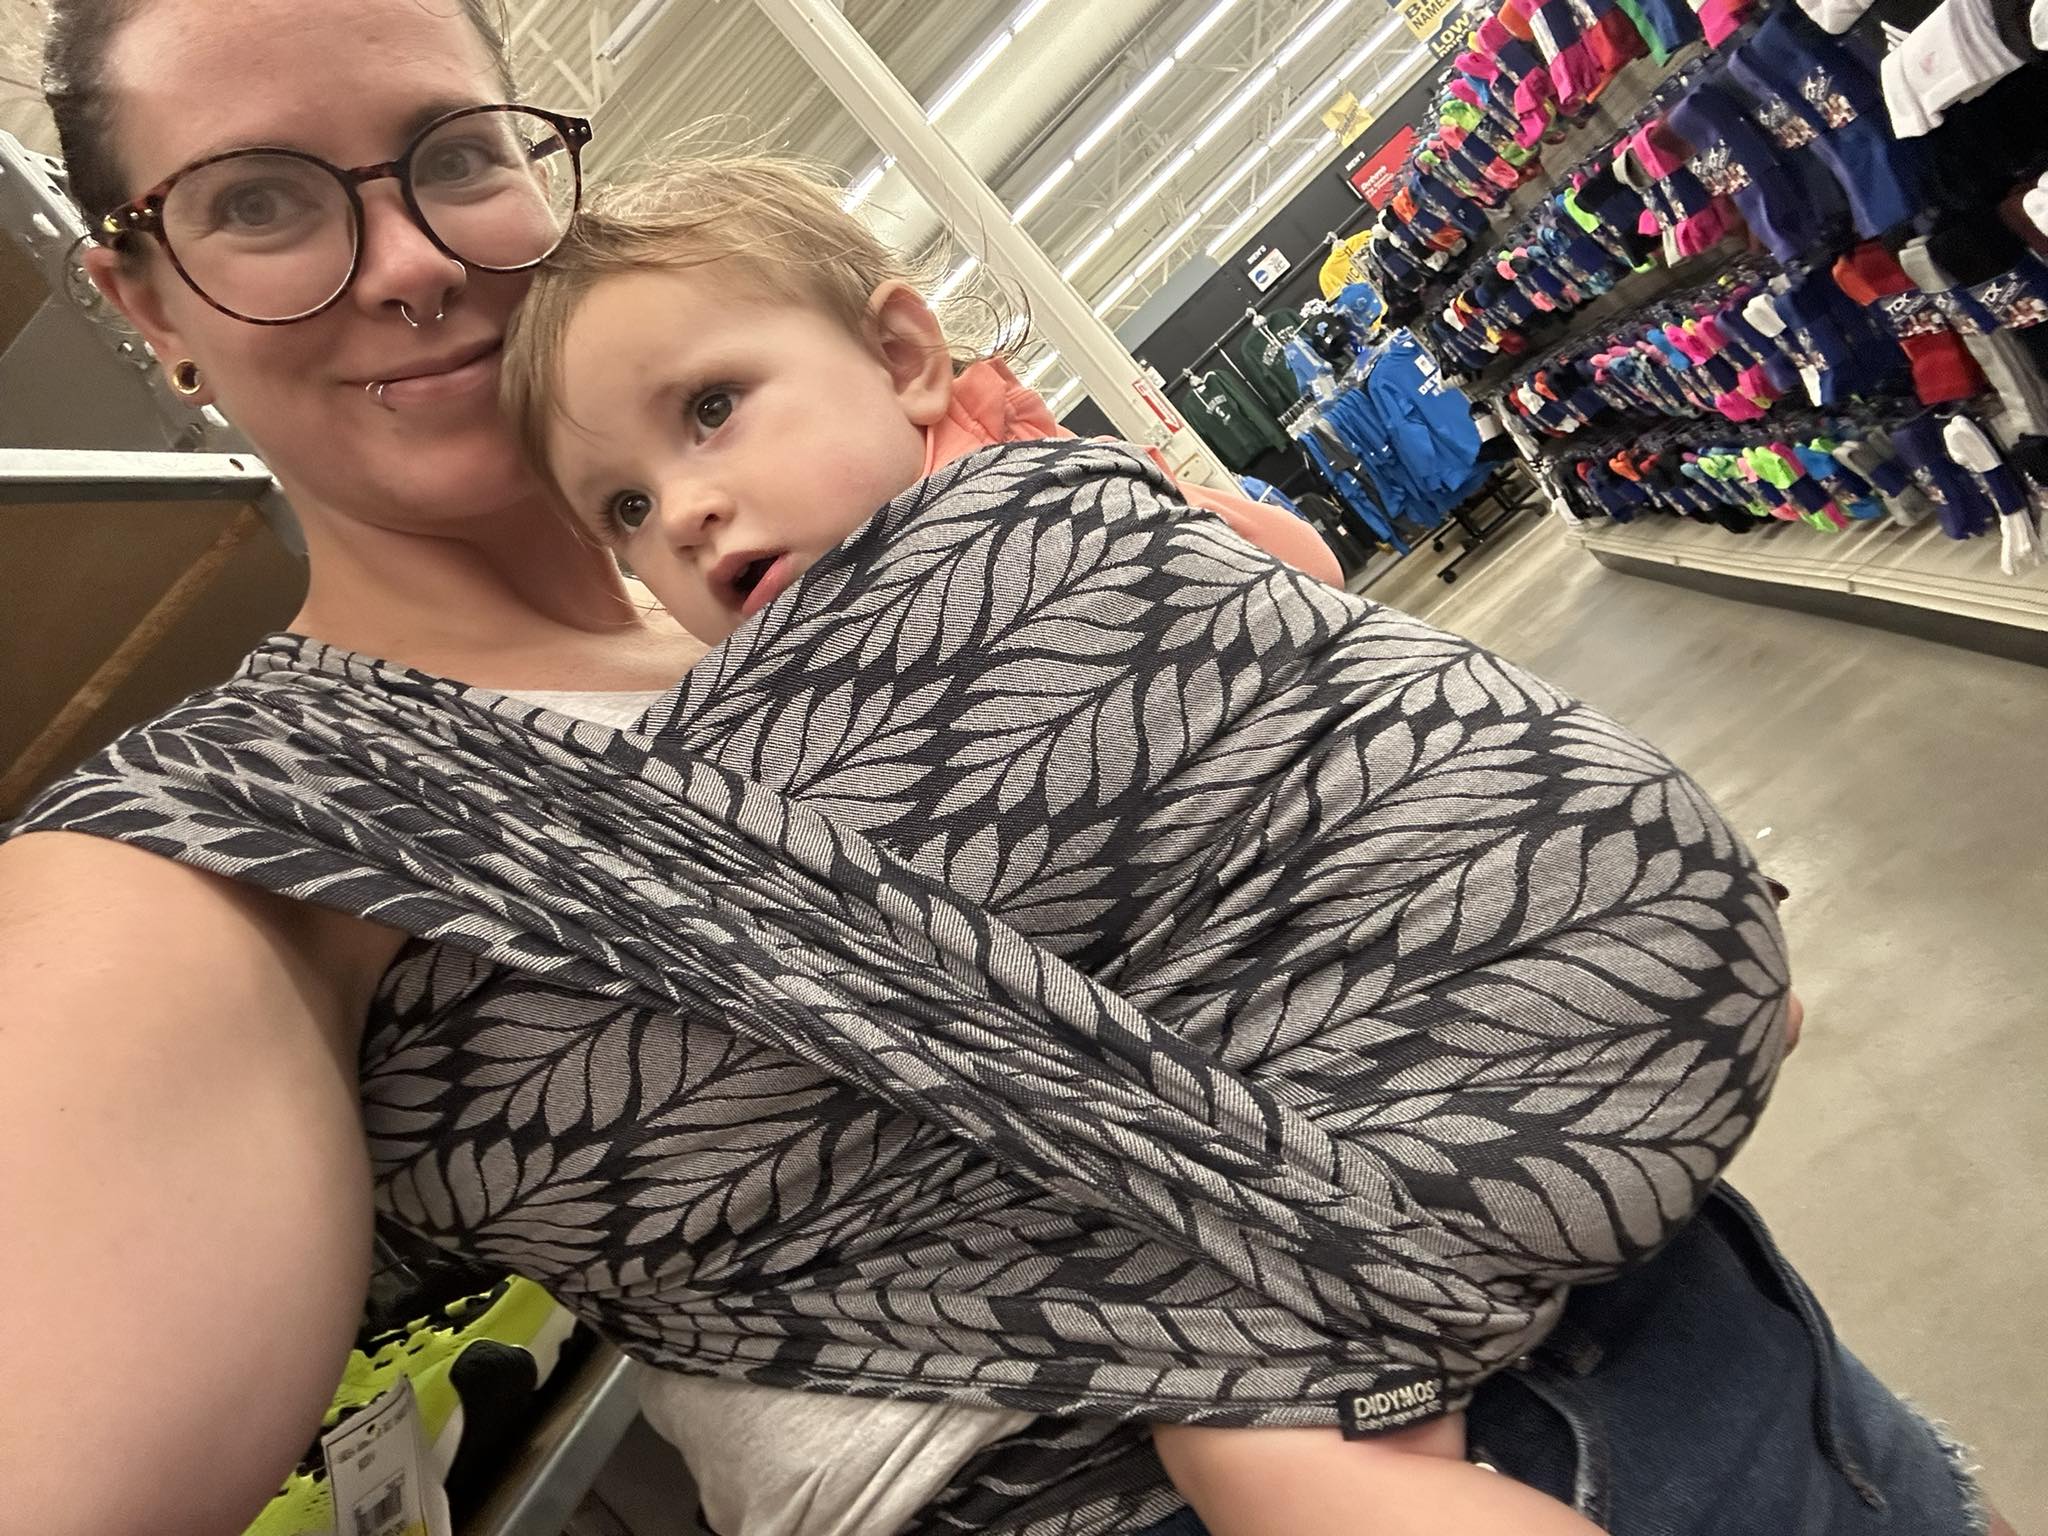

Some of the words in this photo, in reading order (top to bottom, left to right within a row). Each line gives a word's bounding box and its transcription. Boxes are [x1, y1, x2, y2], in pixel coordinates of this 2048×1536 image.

[1412, 0, 1450, 30] NAME
[1431, 13, 1470, 53] LOW
[1353, 1379, 1437, 1419] DIDYMOS
